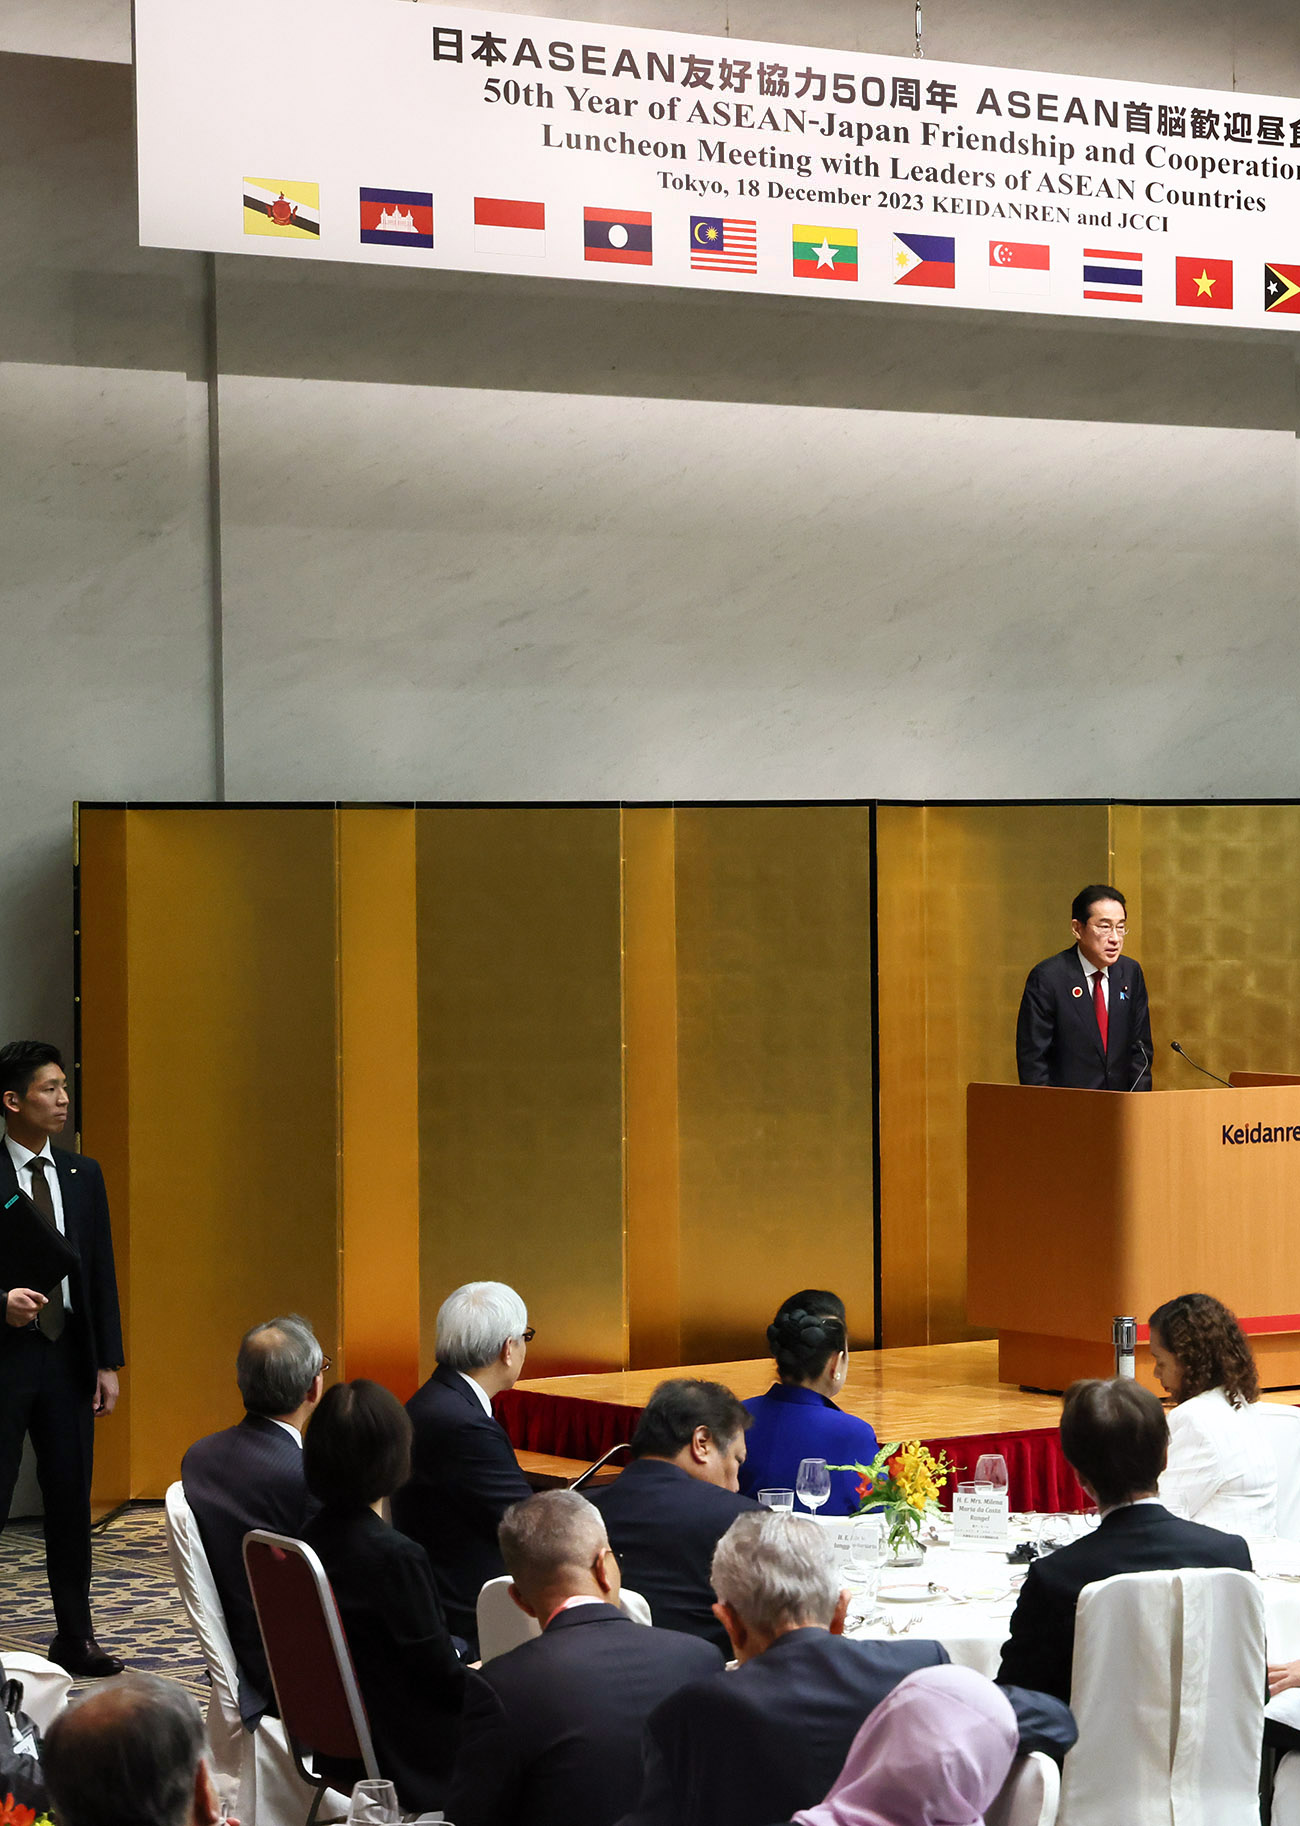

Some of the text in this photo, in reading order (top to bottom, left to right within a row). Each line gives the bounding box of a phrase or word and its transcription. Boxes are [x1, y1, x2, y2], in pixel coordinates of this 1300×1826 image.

[433, 27, 957, 114] 日本ASEAN友好協力50周年
[484, 78, 553, 108] 50th
[565, 86, 638, 116] Year
[649, 97, 681, 121] of
[687, 100, 909, 146] ASEAN-Japan
[921, 122, 1074, 165] Friendship
[1086, 143, 1134, 165] and
[543, 124, 1265, 212] Luncheon Meeting with Leaders of ASEAN Countries
[657, 172, 1167, 232] Tokyo, 18 December 2023 KEIDANREN and JCCI
